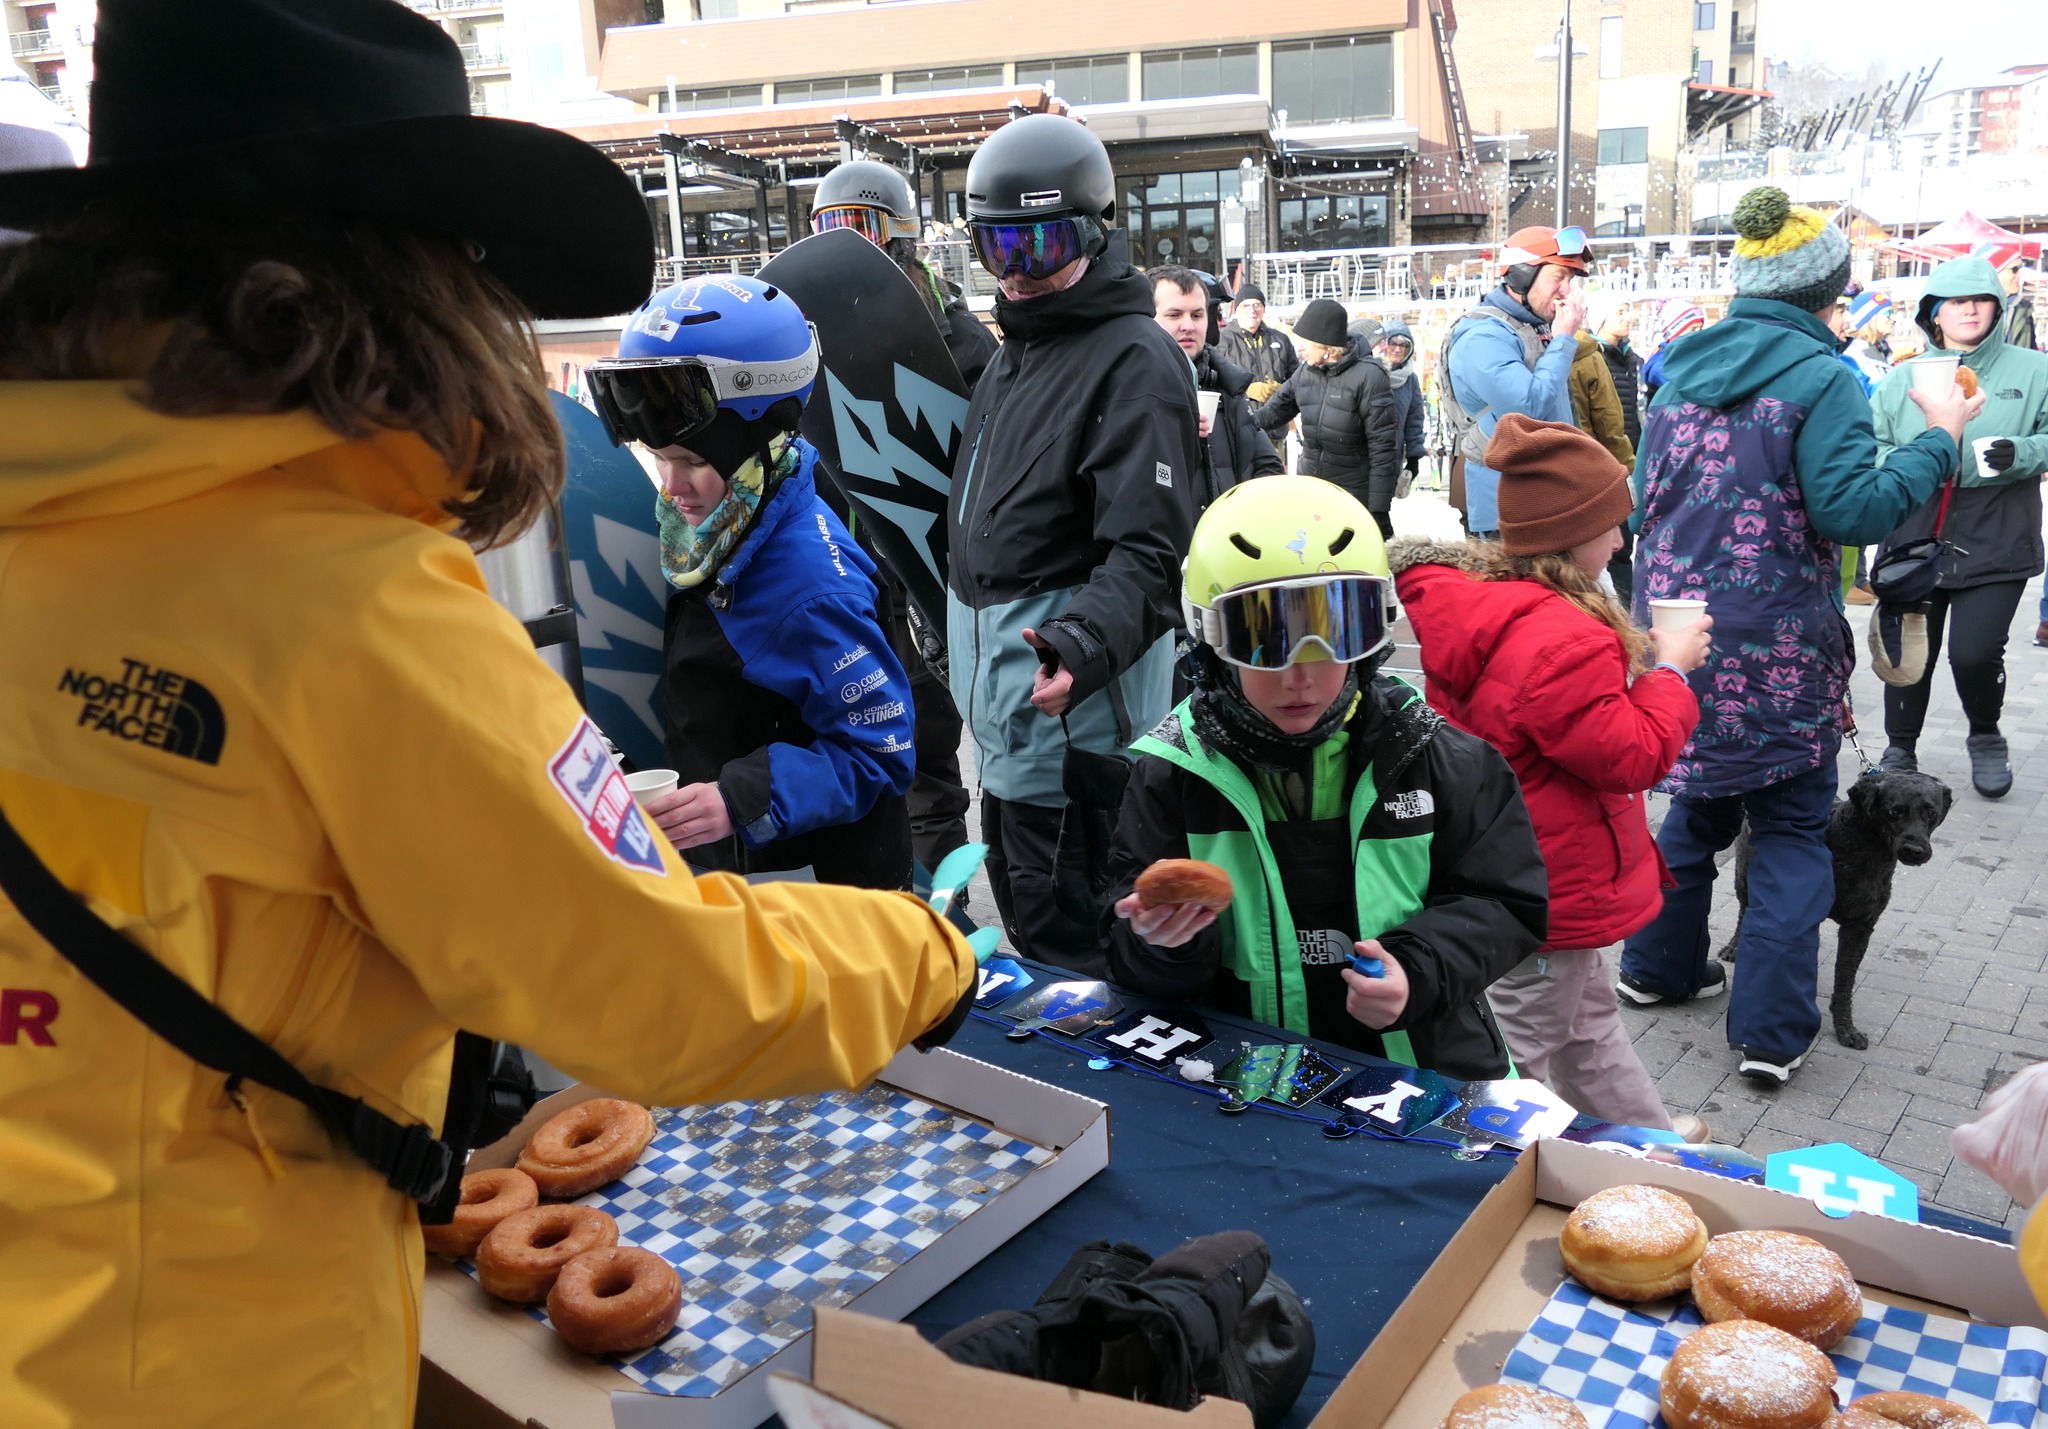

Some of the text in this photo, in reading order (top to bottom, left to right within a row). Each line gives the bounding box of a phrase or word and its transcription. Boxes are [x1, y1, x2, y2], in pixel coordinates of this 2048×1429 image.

[758, 362, 813, 386] DRAGON
[1158, 467, 1170, 480] 686
[120, 657, 187, 698] THE
[57, 668, 178, 724] NORTH
[863, 701, 896, 713] HONEY
[863, 702, 906, 725] STINGER
[77, 702, 168, 748] FACE
[1396, 790, 1417, 802] THE
[1384, 799, 1420, 812] NORTH
[1395, 807, 1422, 819] FACE
[1296, 929, 1327, 941] THE
[1298, 941, 1328, 953] RTH
[1300, 952, 1329, 965] ACE
